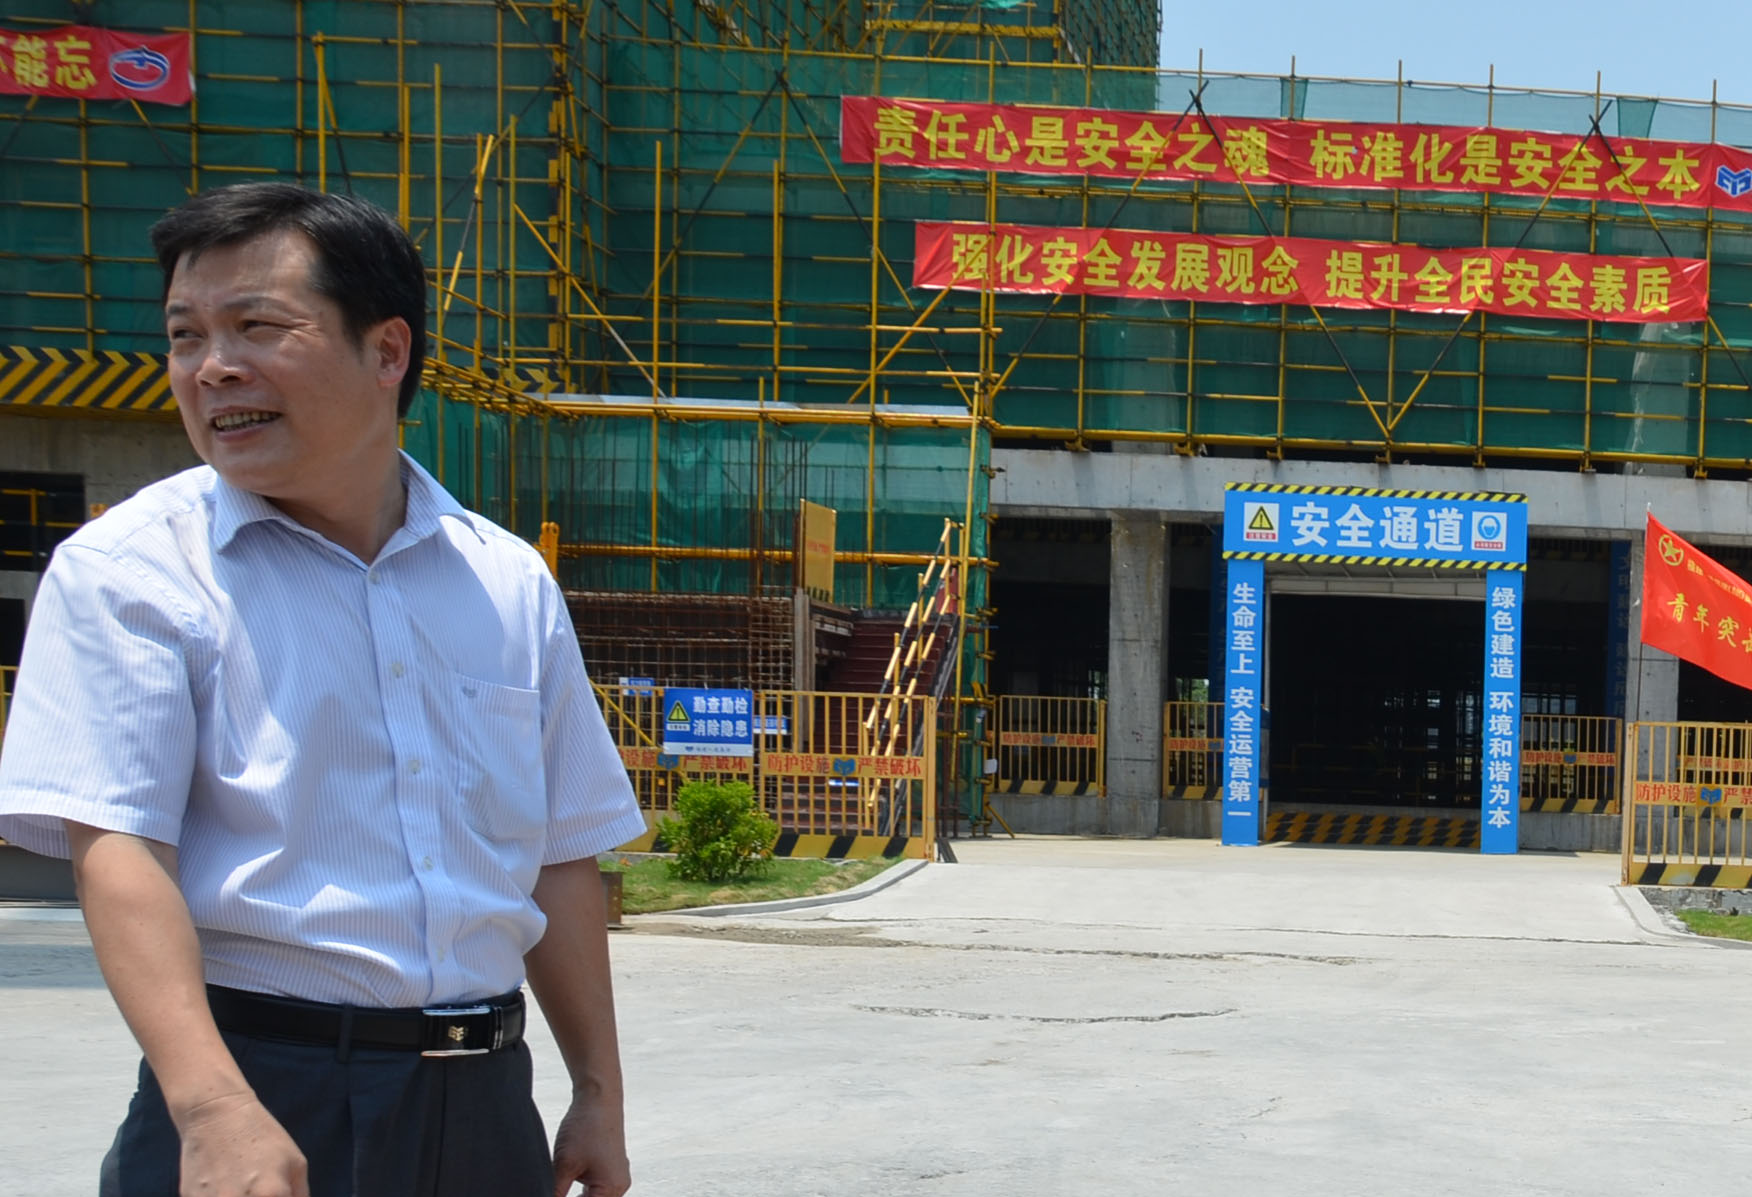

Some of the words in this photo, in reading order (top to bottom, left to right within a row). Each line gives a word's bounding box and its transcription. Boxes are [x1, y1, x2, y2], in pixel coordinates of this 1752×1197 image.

[0, 34, 97, 89] 能忘
[873, 106, 1270, 178] 责任心是安全之魂
[1310, 130, 1701, 199] 标准化是安全之本
[952, 233, 1298, 296] 强化安全发展观念
[1326, 249, 1673, 315] 提升全民安全素质
[1290, 501, 1464, 552] 安全通道
[1229, 580, 1258, 676] 生命至上
[1489, 585, 1516, 680] 绿色建造
[692, 718, 749, 738] 消除隐患
[767, 753, 831, 775] 防护设施
[856, 756, 922, 778] 严禁破坏
[1226, 685, 1255, 818] 安全运营第一
[1486, 689, 1514, 829] 环境和谐为本
[1635, 783, 1697, 803] 防护设施
